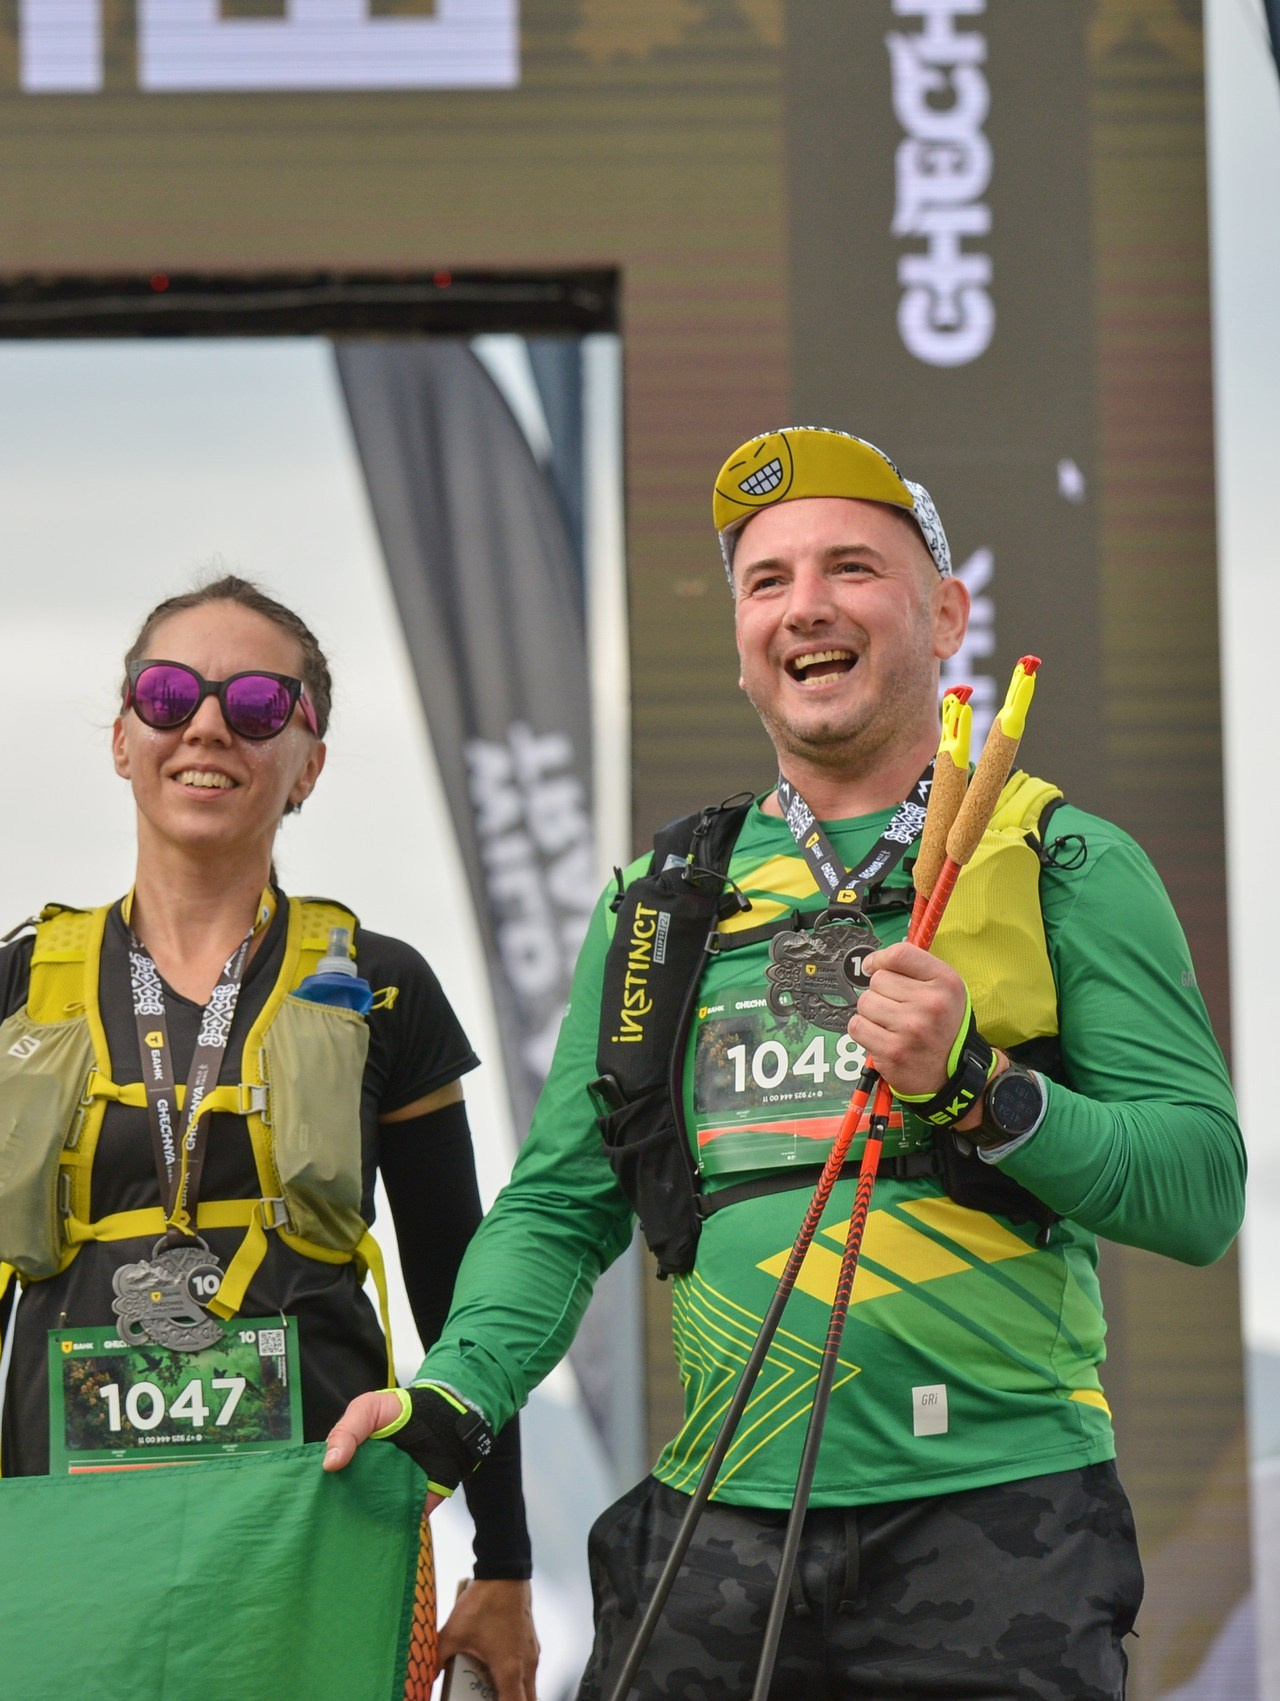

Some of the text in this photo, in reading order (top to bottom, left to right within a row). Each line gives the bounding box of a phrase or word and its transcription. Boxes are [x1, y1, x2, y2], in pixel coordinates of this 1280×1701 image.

[150, 1049, 164, 1081] БАНК
[726, 1033, 867, 1093] 1048
[156, 1098, 176, 1166] CHECHNYA
[192, 1274, 220, 1296] 10
[238, 1330, 256, 1344] 10
[98, 1376, 247, 1432] 1047
[921, 1392, 938, 1406] GRi
